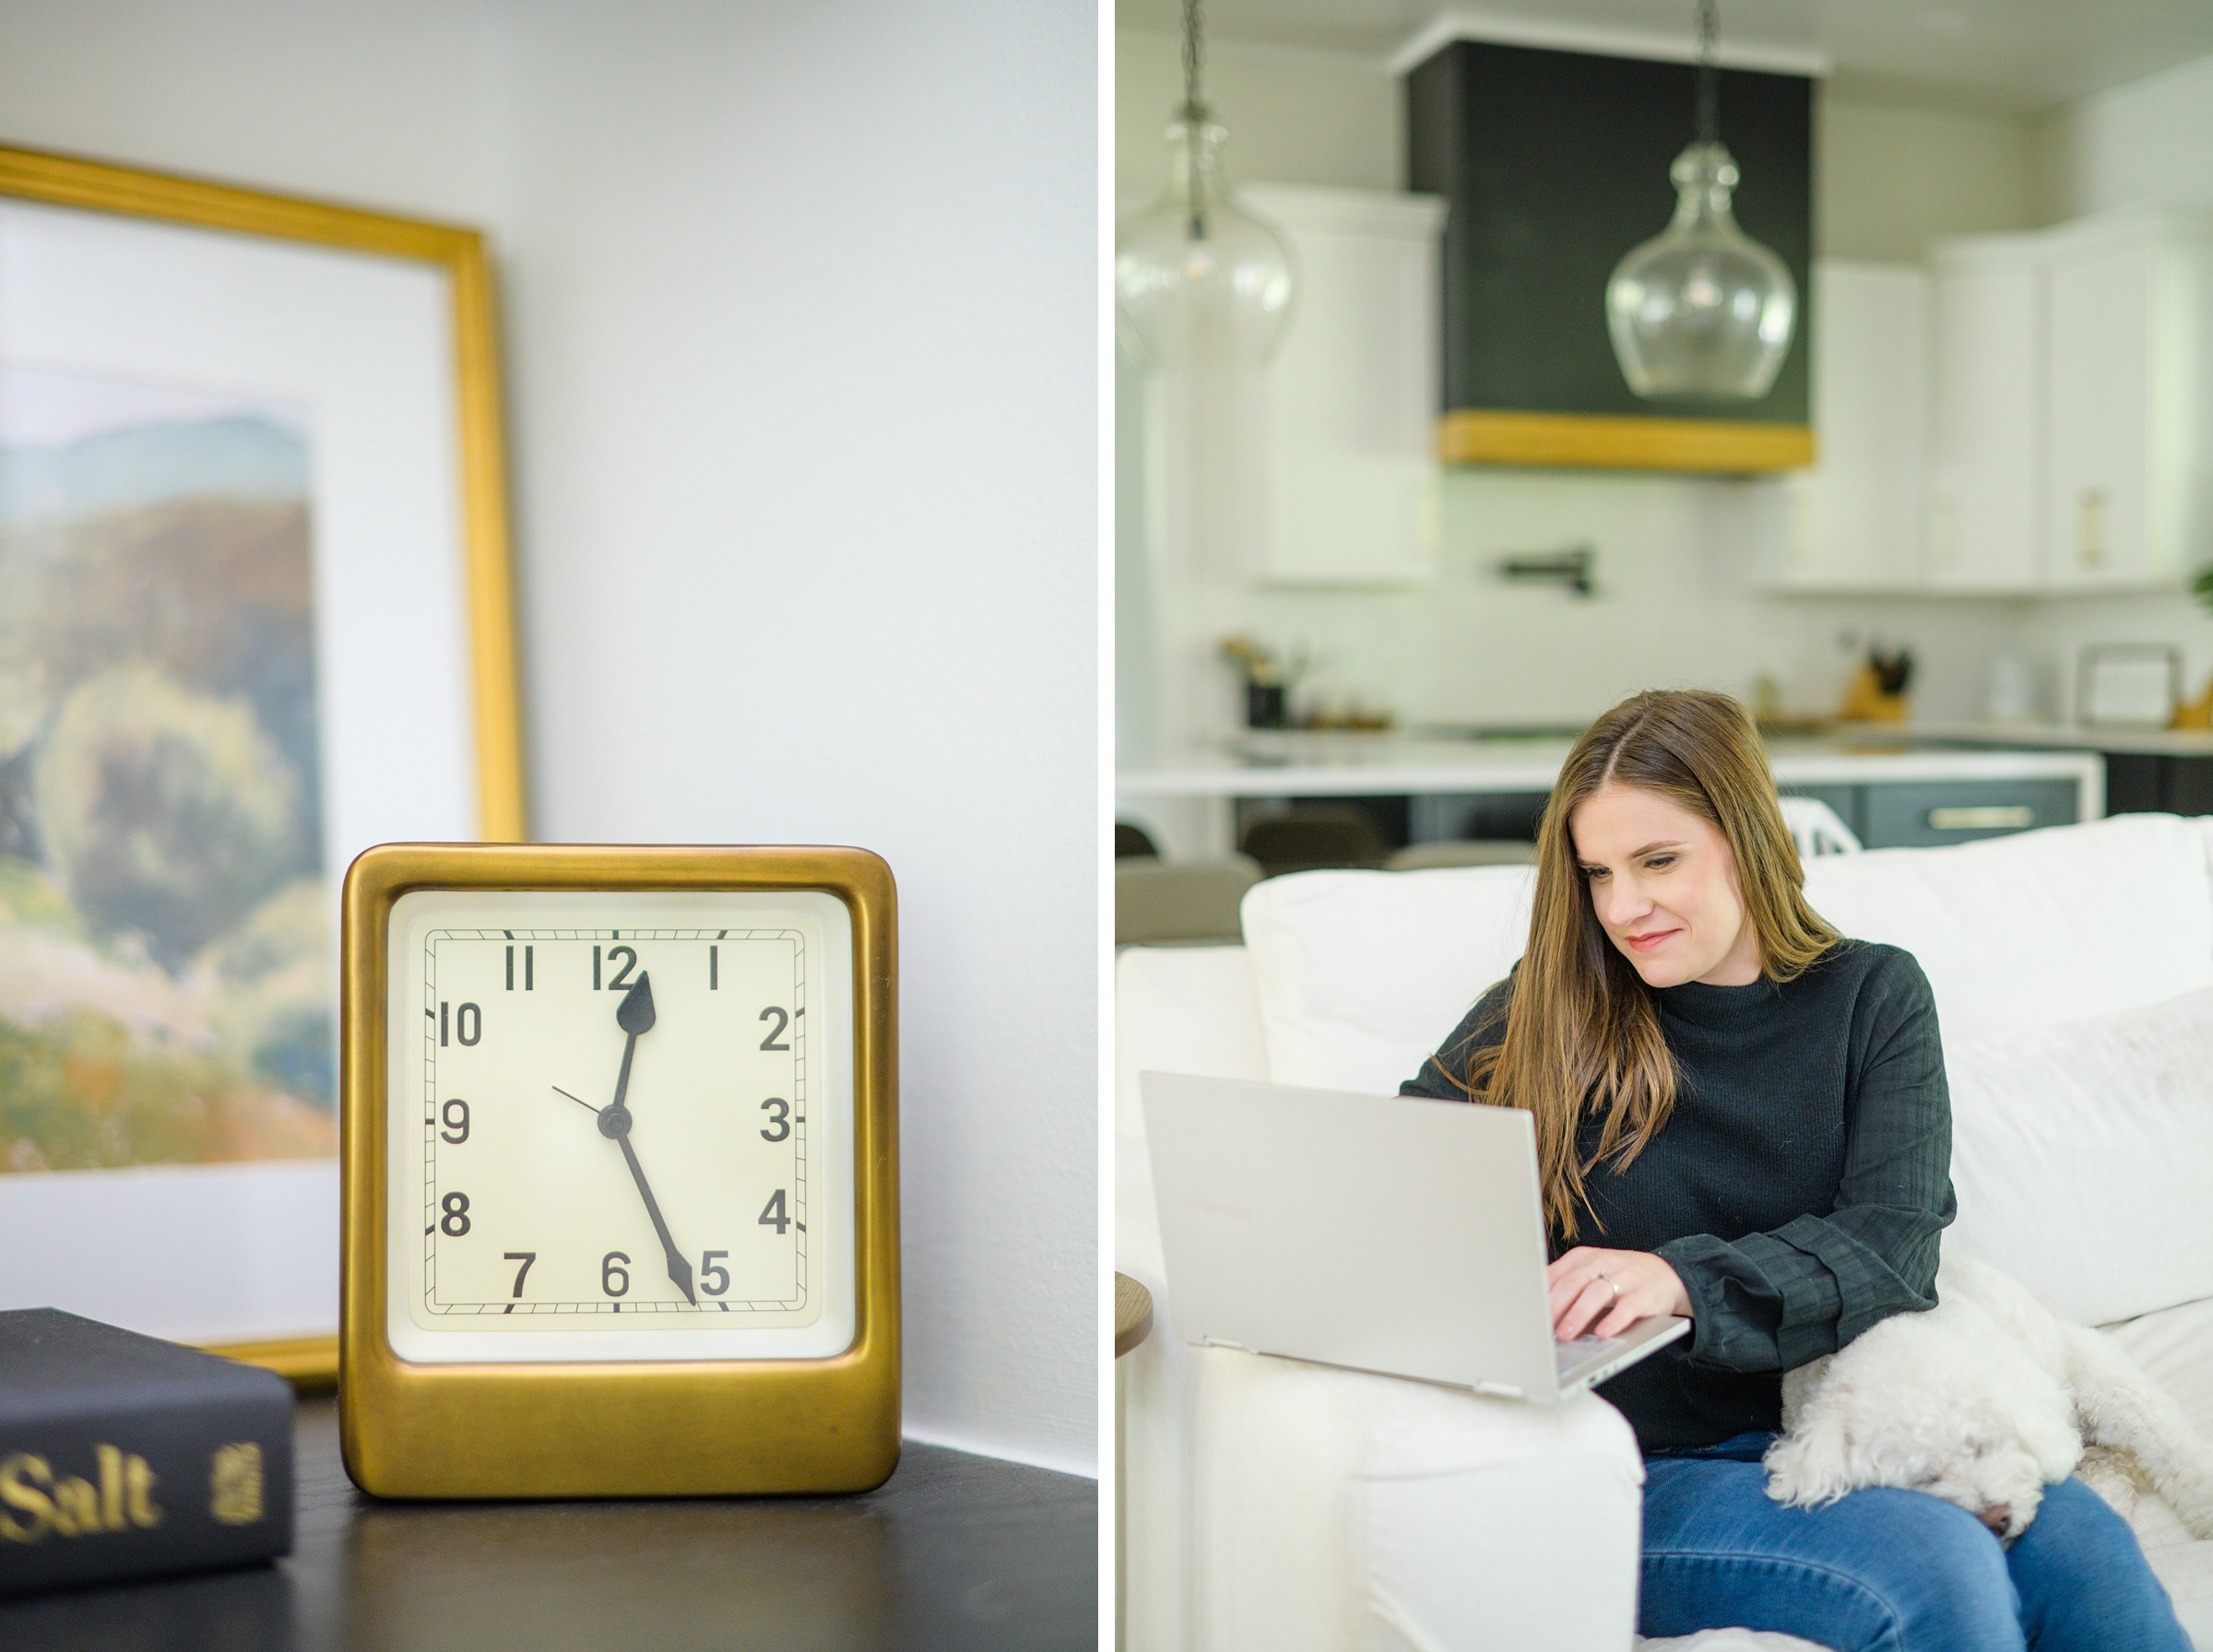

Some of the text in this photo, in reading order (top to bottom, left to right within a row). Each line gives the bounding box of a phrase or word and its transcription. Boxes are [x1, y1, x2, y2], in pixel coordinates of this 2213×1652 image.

[506, 945, 534, 991] 11
[593, 945, 638, 991] 12
[709, 945, 718, 991] 1
[440, 1001, 481, 1047] 10
[759, 1006, 790, 1051] 2
[440, 1099, 470, 1145] 9
[759, 1097, 791, 1142] 3
[441, 1191, 471, 1237] 8
[758, 1188, 791, 1234] 4
[503, 1252, 537, 1298] 7
[601, 1251, 632, 1297] 6
[699, 1250, 730, 1296] 5
